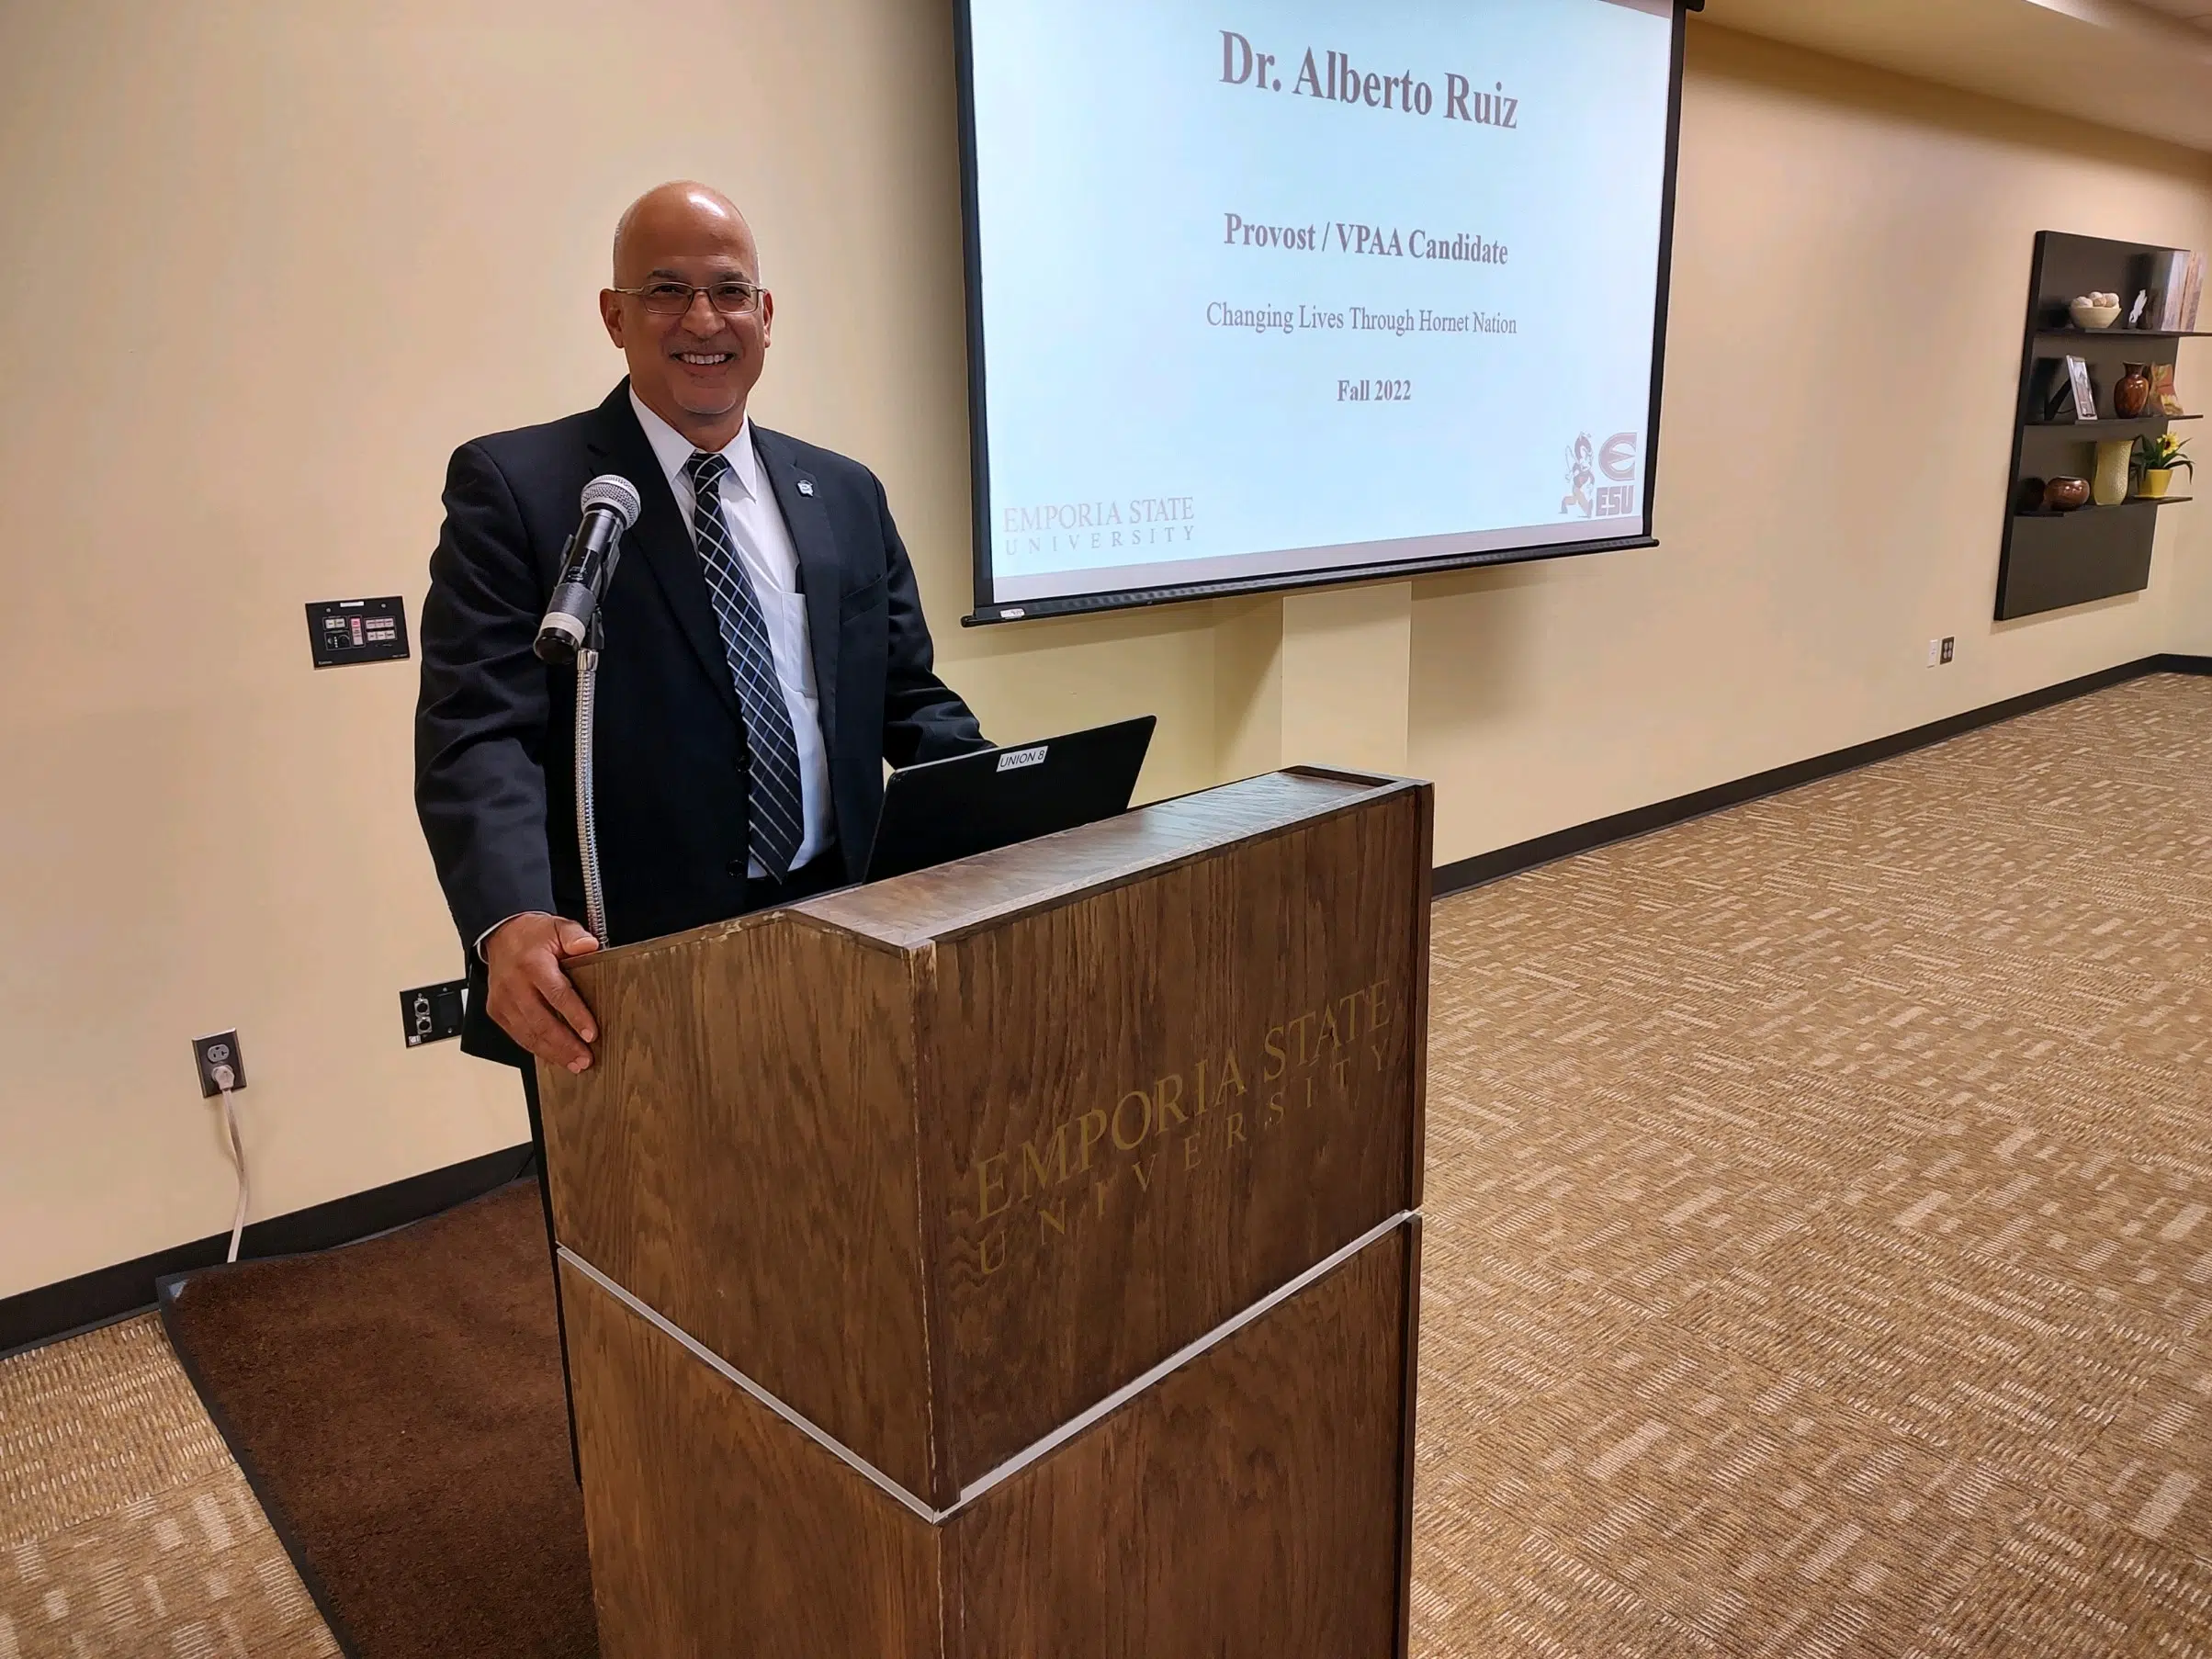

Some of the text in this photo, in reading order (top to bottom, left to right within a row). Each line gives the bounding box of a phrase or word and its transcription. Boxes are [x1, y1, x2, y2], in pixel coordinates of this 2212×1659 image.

[1219, 28, 1518, 129] Dr. Alberto Ruiz
[1224, 212, 1508, 265] Provost / VPAA Candidate
[1206, 301, 1518, 336] Changing Lives Through Hornet Nation
[1337, 379, 1411, 401] Fall 2022
[1003, 496, 1195, 532] EMPORIA STATE
[1596, 485, 1634, 516] ESU
[1005, 525, 1195, 556] UNIVERSITY
[1000, 750, 1044, 767] UNION 8
[976, 979, 1391, 1224] EMPORIA STATE
[977, 1044, 1391, 1276] UNIVERSITY
